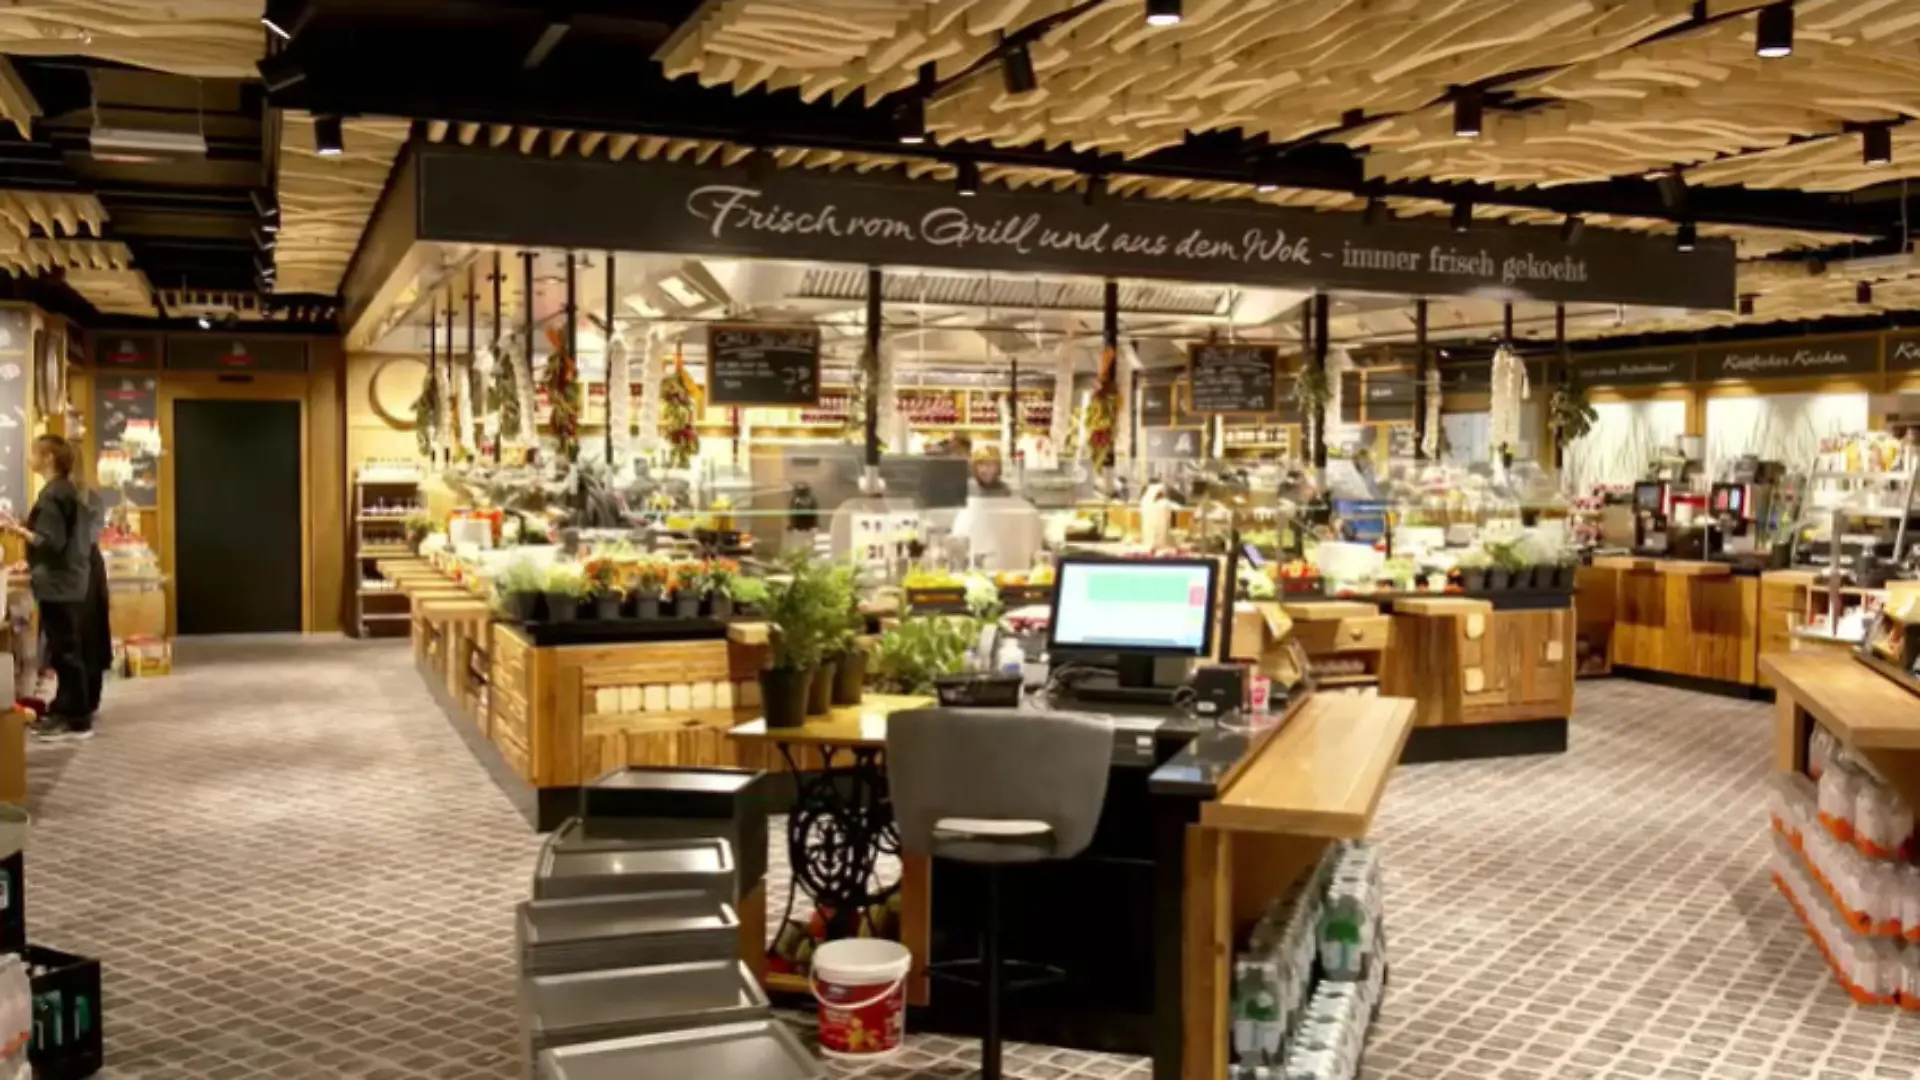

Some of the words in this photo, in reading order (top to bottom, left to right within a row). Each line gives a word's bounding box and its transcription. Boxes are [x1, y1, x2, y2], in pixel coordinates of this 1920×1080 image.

[686, 184, 842, 238] Frisch
[847, 216, 916, 241] vom
[920, 206, 1040, 254] Grill
[1038, 222, 1110, 253] und
[1111, 233, 1168, 256] aus
[1175, 229, 1239, 260] dem
[1242, 227, 1312, 265] Wok
[1342, 239, 1421, 271] immer
[1429, 246, 1495, 277] frisch
[1502, 252, 1588, 285] gekocht
